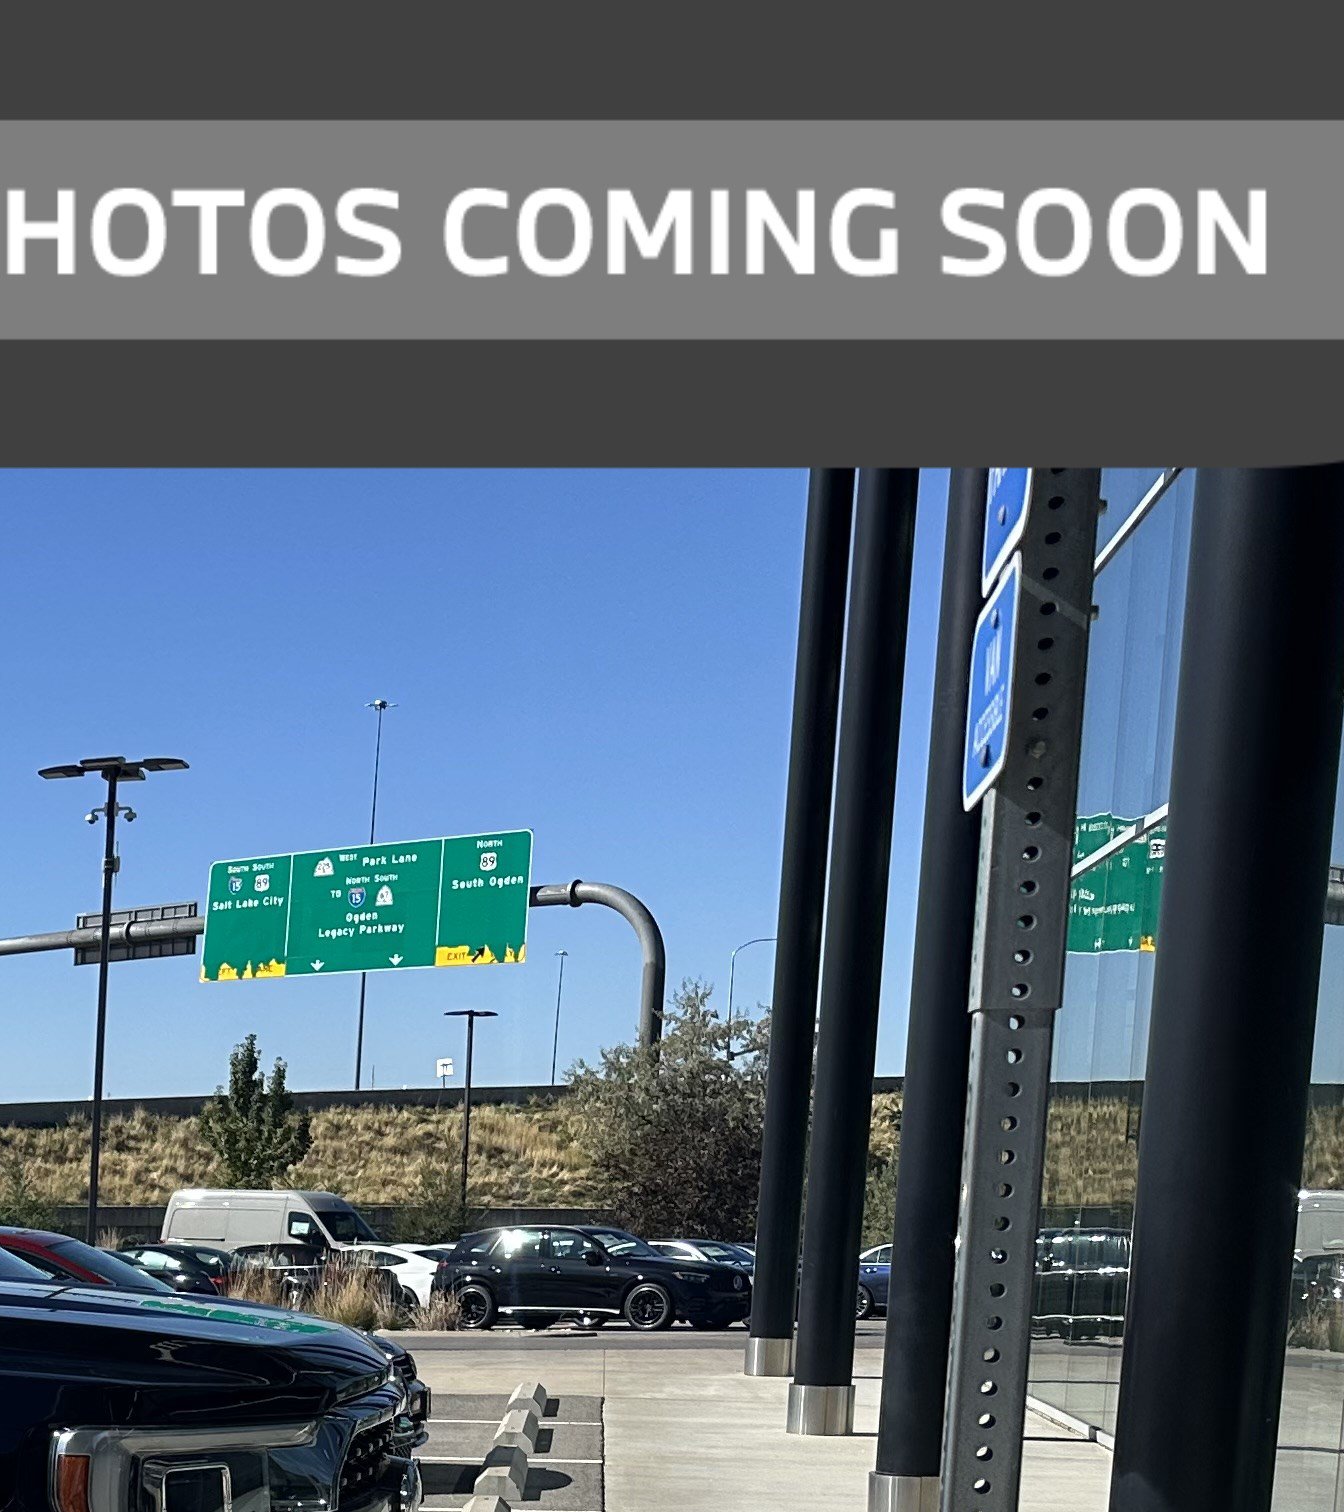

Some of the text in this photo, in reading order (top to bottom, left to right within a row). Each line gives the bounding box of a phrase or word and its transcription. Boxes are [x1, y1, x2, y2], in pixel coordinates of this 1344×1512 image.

[476, 840, 503, 849] NORTH
[339, 854, 358, 862] WEST
[362, 856, 387, 867] Park
[391, 854, 418, 864] Lane
[481, 856, 495, 867] 89
[256, 878, 268, 888] 89
[345, 874, 398, 885] NORTH SOUTH
[451, 875, 524, 890] South Ogden
[330, 889, 342, 898] TO
[352, 893, 361, 904] 15
[212, 896, 284, 911] Salt Lake City
[345, 912, 378, 924] Ogden
[318, 923, 404, 940] Legacy Parkway
[447, 952, 466, 961] EXIT
